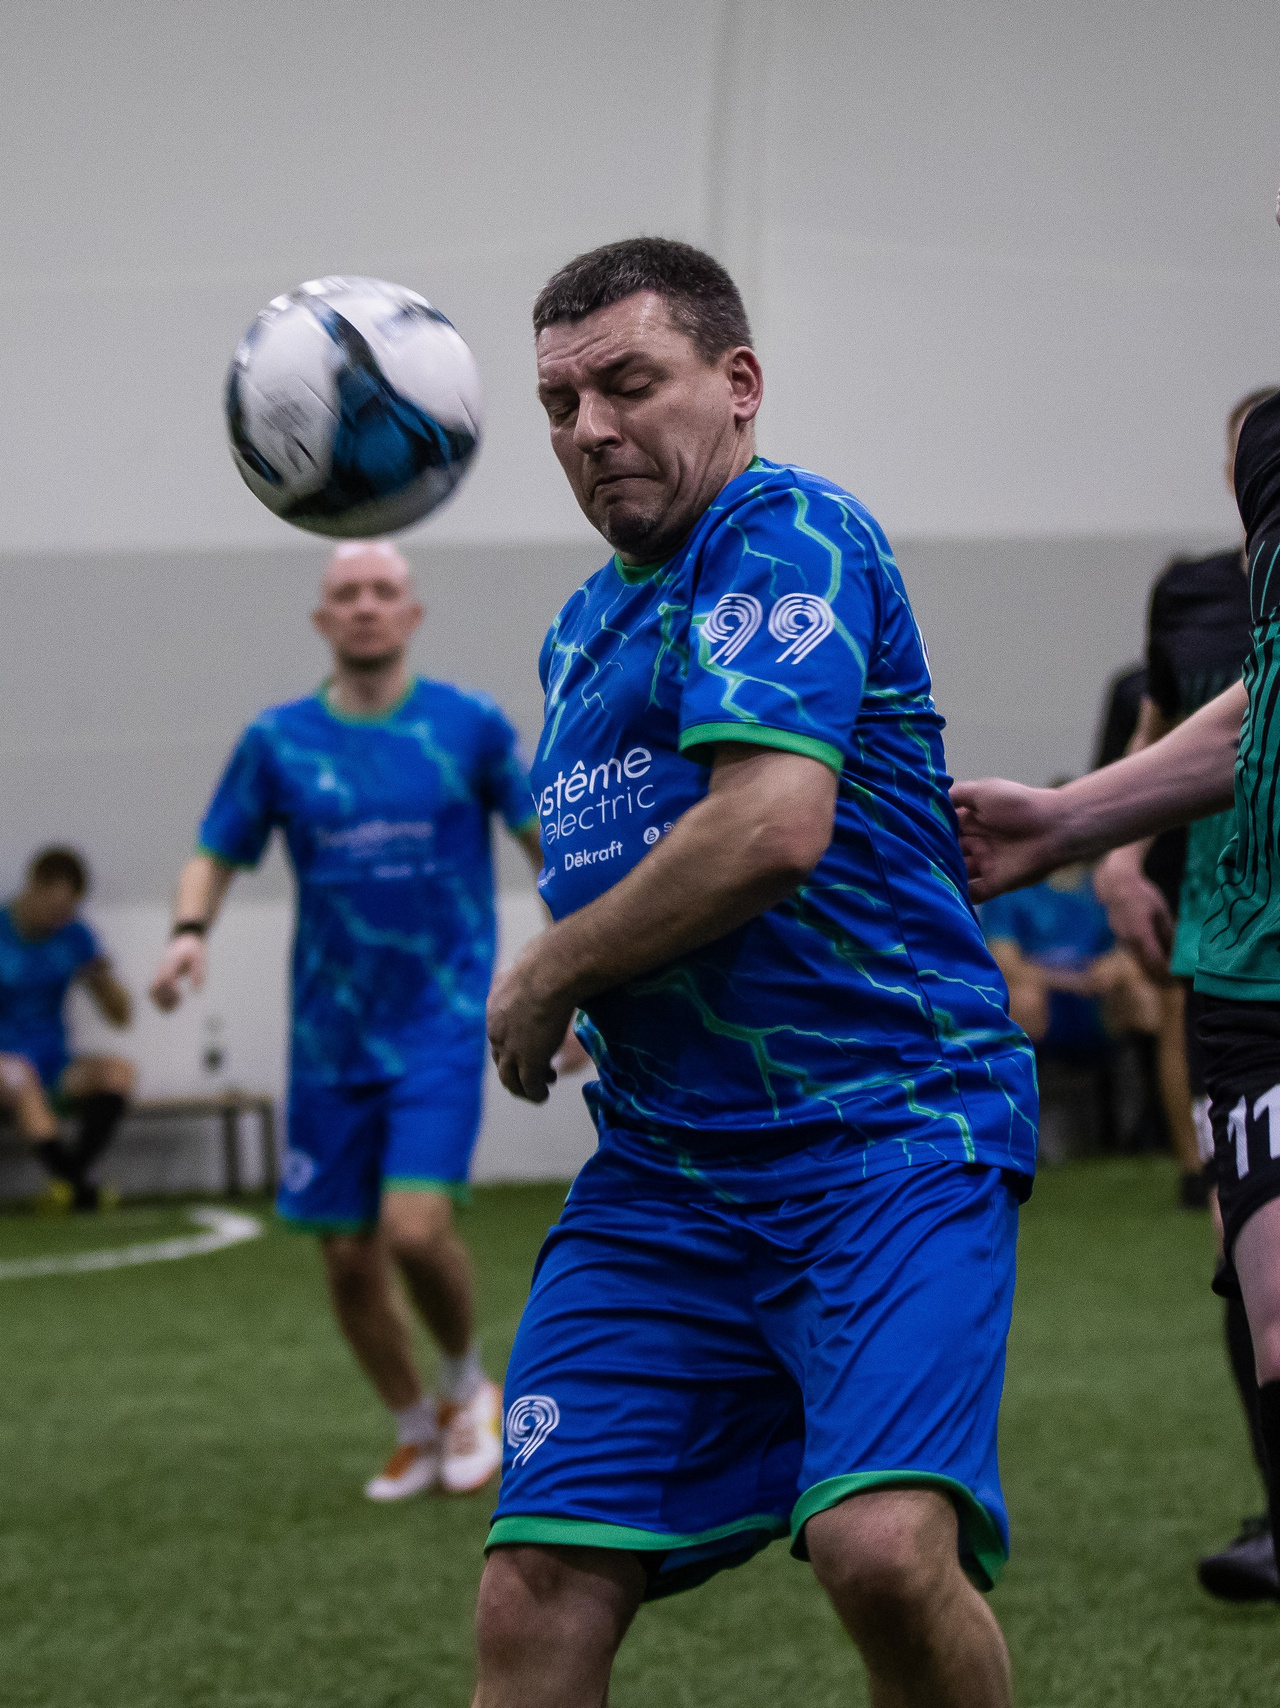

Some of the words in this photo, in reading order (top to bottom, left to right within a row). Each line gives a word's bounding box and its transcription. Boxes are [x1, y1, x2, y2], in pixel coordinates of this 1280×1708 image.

[700, 592, 835, 666] 99
[531, 747, 652, 819] ystême
[544, 784, 656, 845] electric
